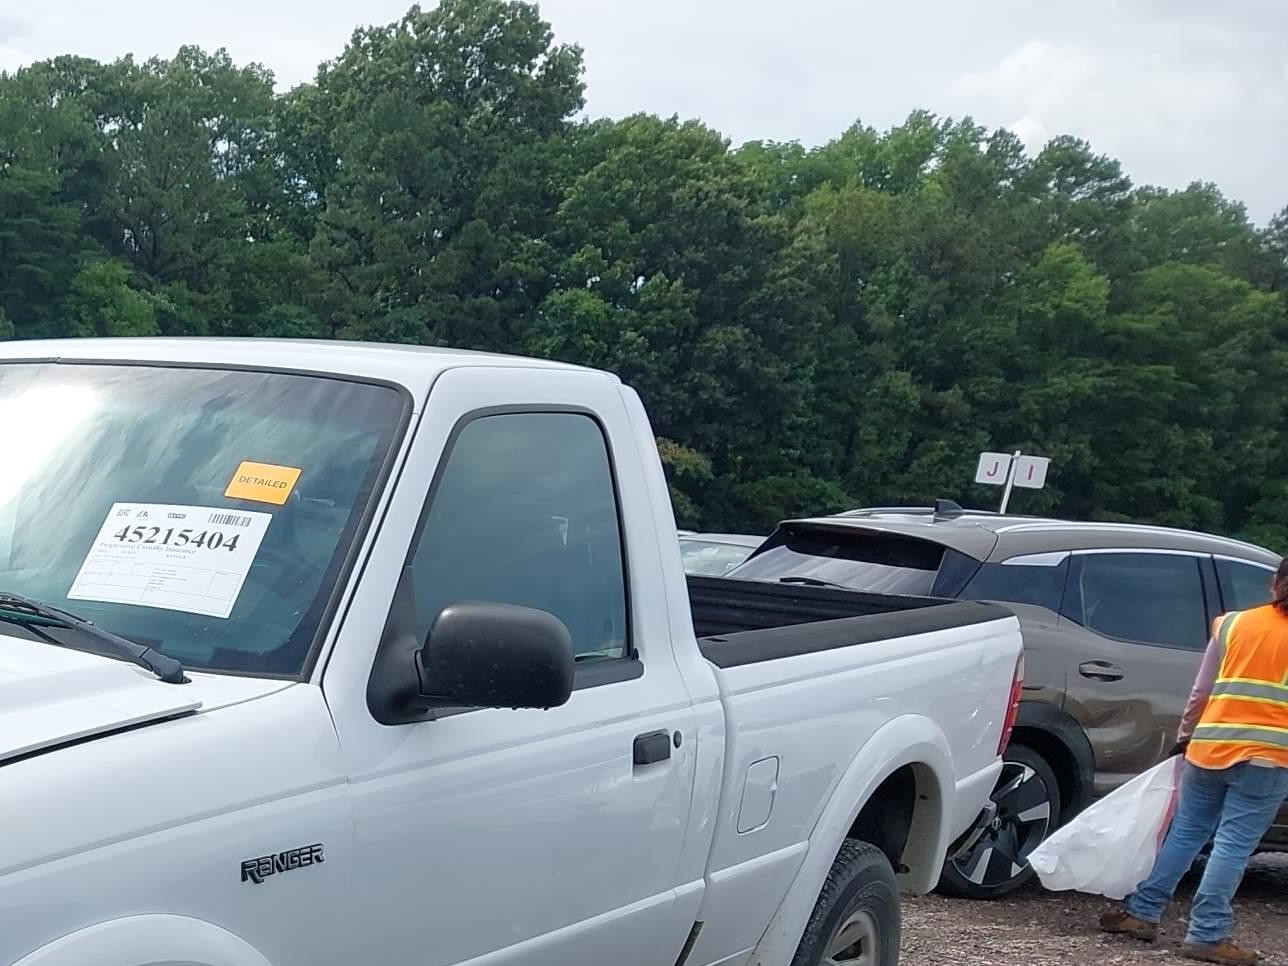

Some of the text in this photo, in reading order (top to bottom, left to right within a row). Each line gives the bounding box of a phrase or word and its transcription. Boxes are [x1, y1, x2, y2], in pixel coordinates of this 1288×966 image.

[986, 461, 999, 477] J
[239, 475, 288, 489] DETAILED
[114, 524, 241, 552] 45215404
[240, 842, 325, 885] RANGER
